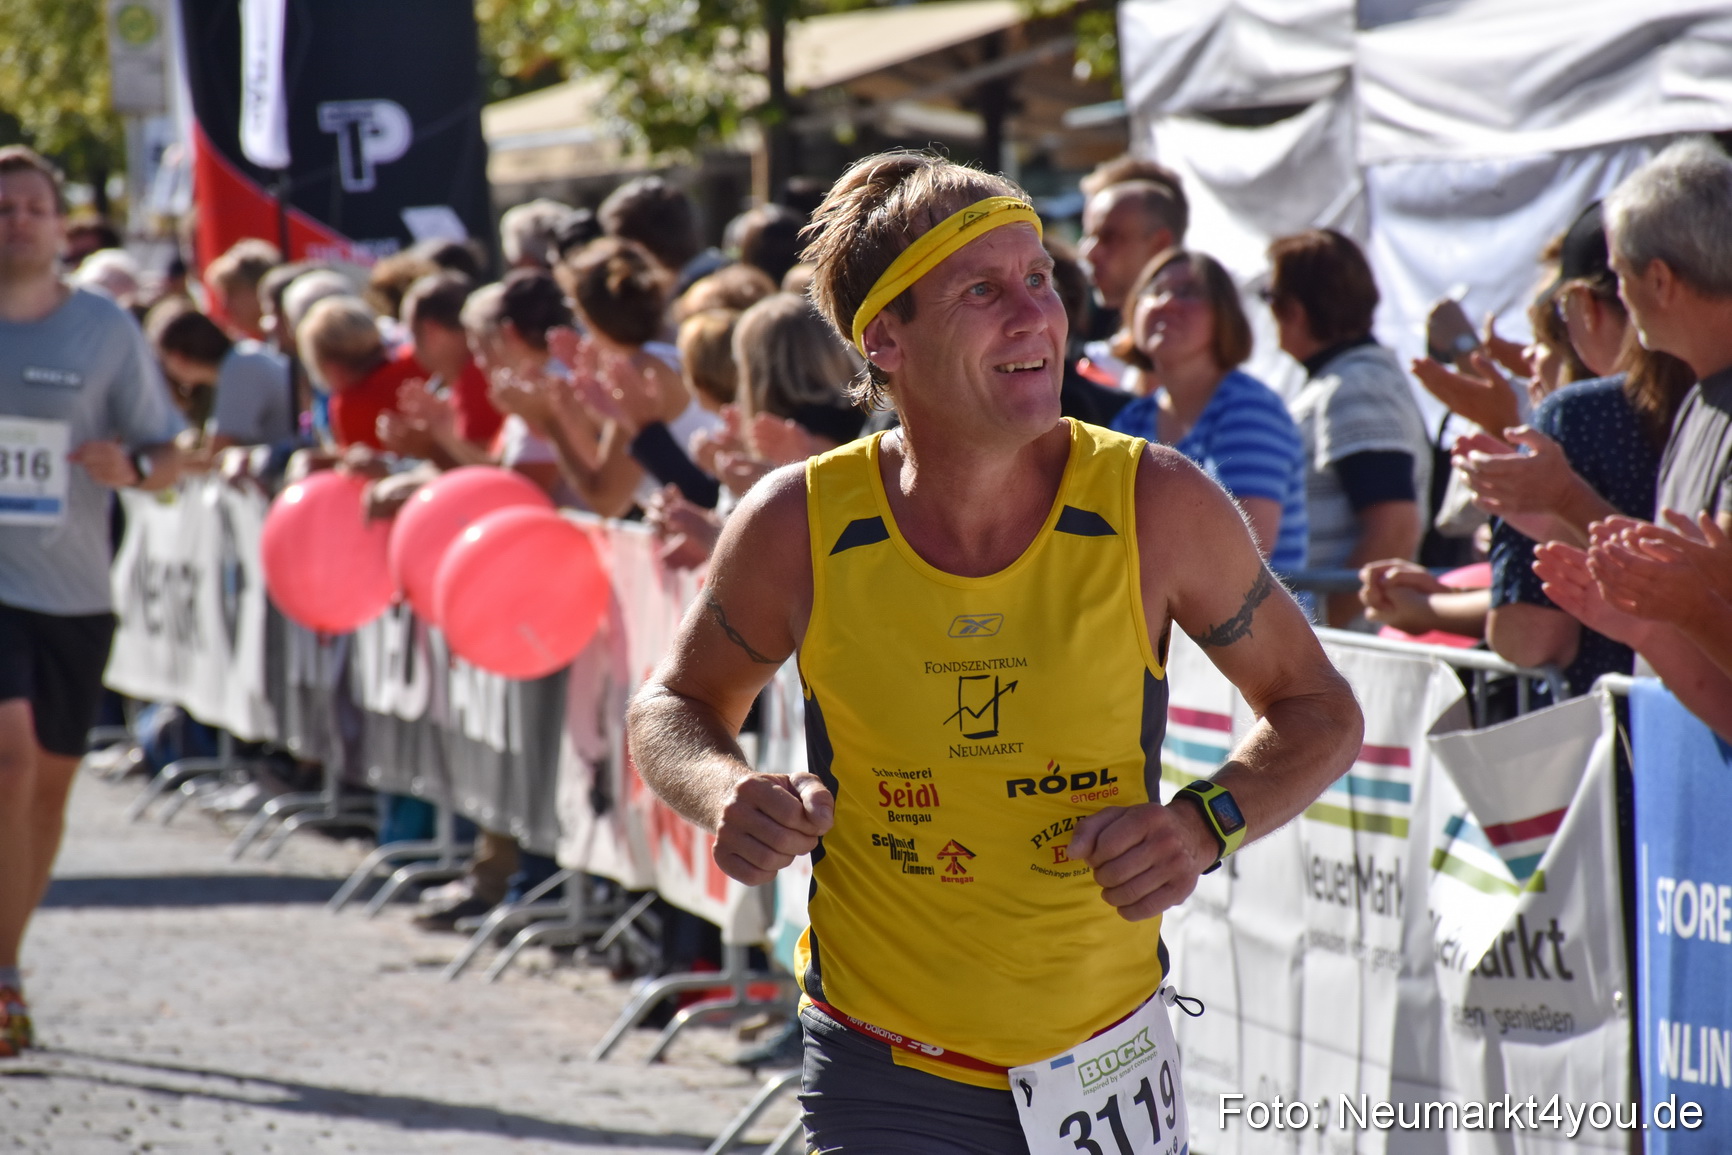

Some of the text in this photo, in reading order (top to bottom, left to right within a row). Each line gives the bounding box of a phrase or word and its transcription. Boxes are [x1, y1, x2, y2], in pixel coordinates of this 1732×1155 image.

[924, 657, 1028, 674] FONDSZENTRUM
[948, 742, 1024, 759] NEUMARKT
[871, 767, 933, 779] Schreinerei
[878, 780, 941, 808] Seidl
[887, 810, 932, 825] Berngau
[1030, 815, 1087, 850] PIZZ
[1656, 875, 1732, 944] STORE
[865, 1023, 903, 1043] balance
[1078, 1026, 1156, 1088] BOCK
[1082, 1078, 1110, 1097] inspired
[1109, 1073, 1119, 1084] by
[1059, 1059, 1176, 1155] 3119
